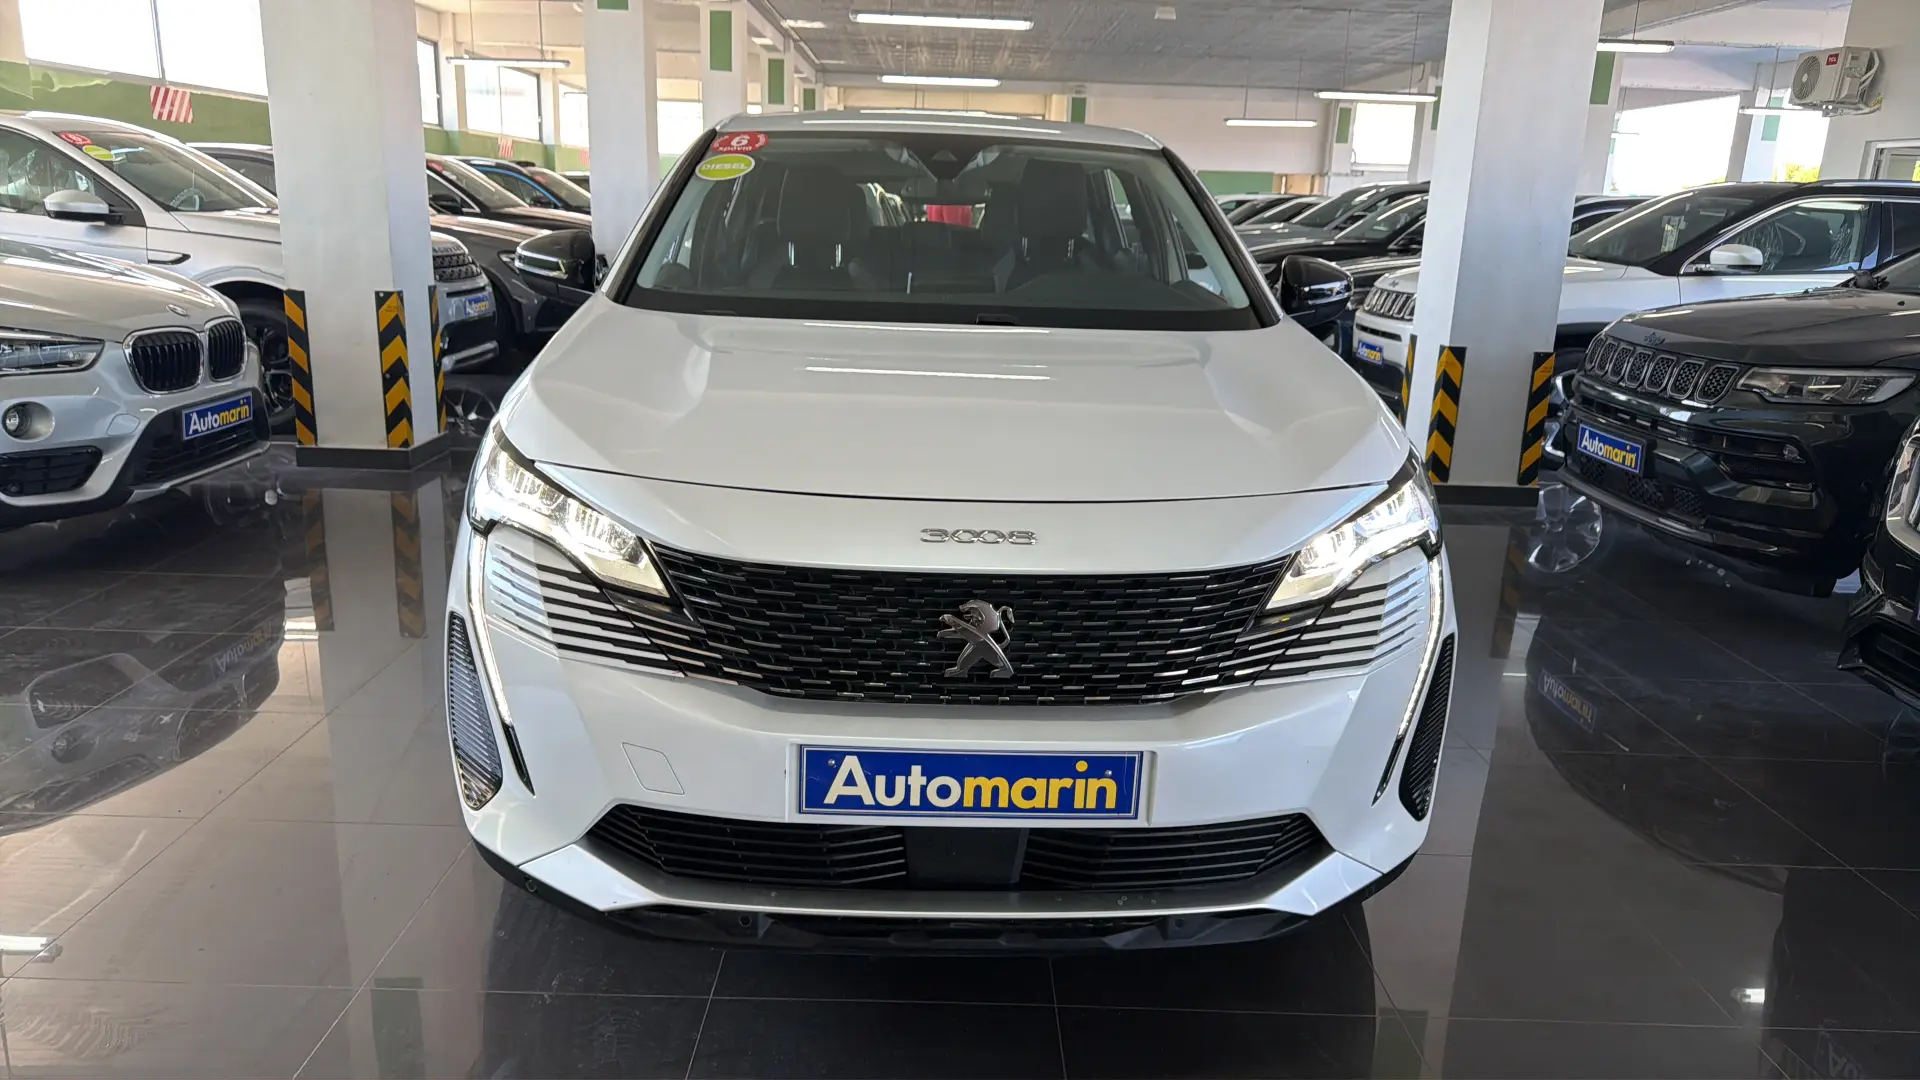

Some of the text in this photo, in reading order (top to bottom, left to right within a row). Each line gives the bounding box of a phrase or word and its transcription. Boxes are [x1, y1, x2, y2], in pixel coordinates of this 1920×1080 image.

[731, 134, 750, 147] 6
[702, 162, 748, 171] DIESEL
[188, 399, 249, 435] Automarin
[1581, 429, 1637, 469] Automarin
[920, 528, 1038, 545] 3008
[823, 755, 1118, 810] Automarin
